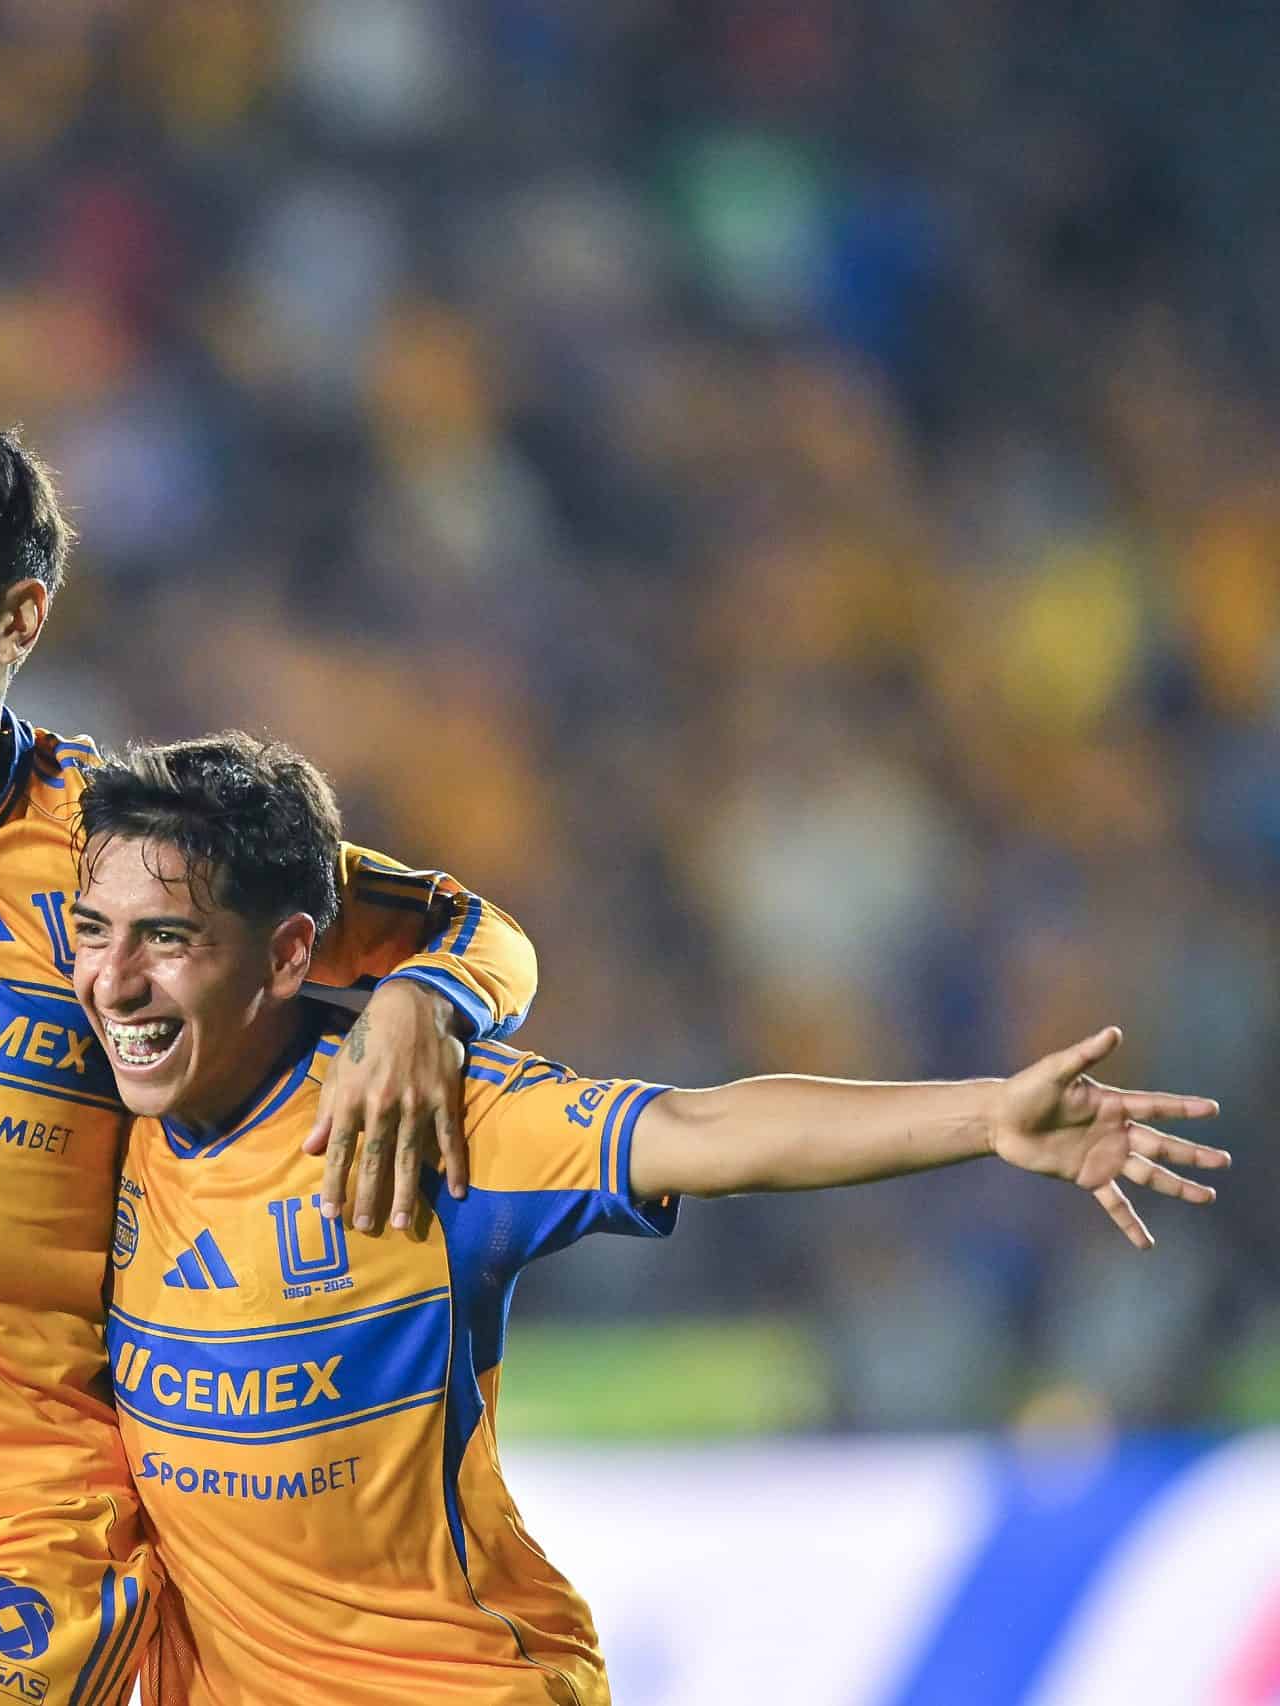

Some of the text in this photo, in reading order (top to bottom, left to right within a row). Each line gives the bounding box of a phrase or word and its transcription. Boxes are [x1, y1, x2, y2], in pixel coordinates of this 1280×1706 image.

[267, 1193, 350, 1286] U
[282, 1285, 312, 1300] 1960
[323, 1277, 354, 1293] 2025
[151, 1354, 344, 1416] CEMEX
